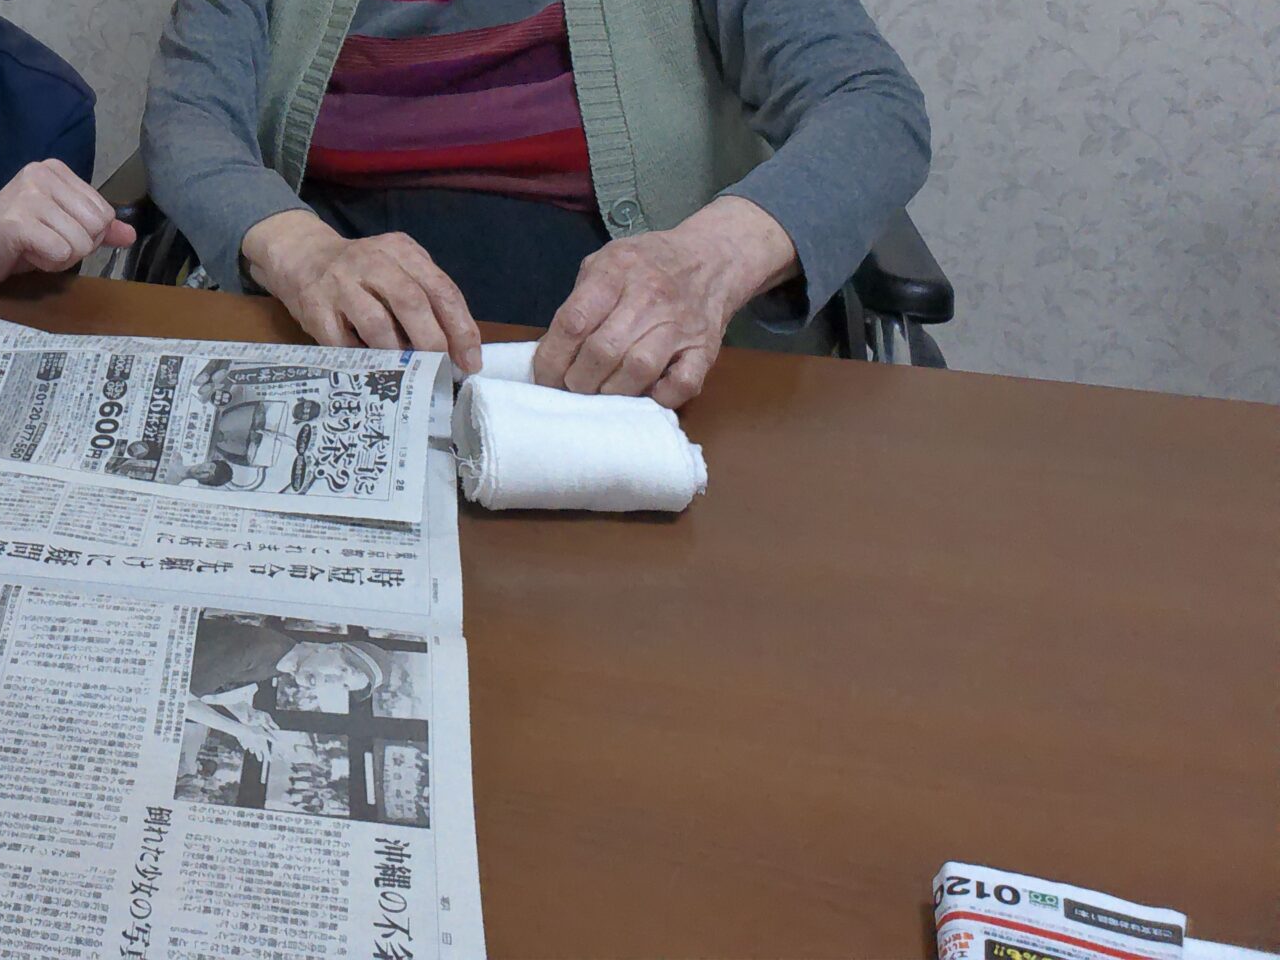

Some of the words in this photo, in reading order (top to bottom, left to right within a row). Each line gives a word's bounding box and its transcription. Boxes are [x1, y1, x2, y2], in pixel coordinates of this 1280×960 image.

[356, 401, 390, 495] これ本当に
[248, 564, 406, 588] 時短命令
